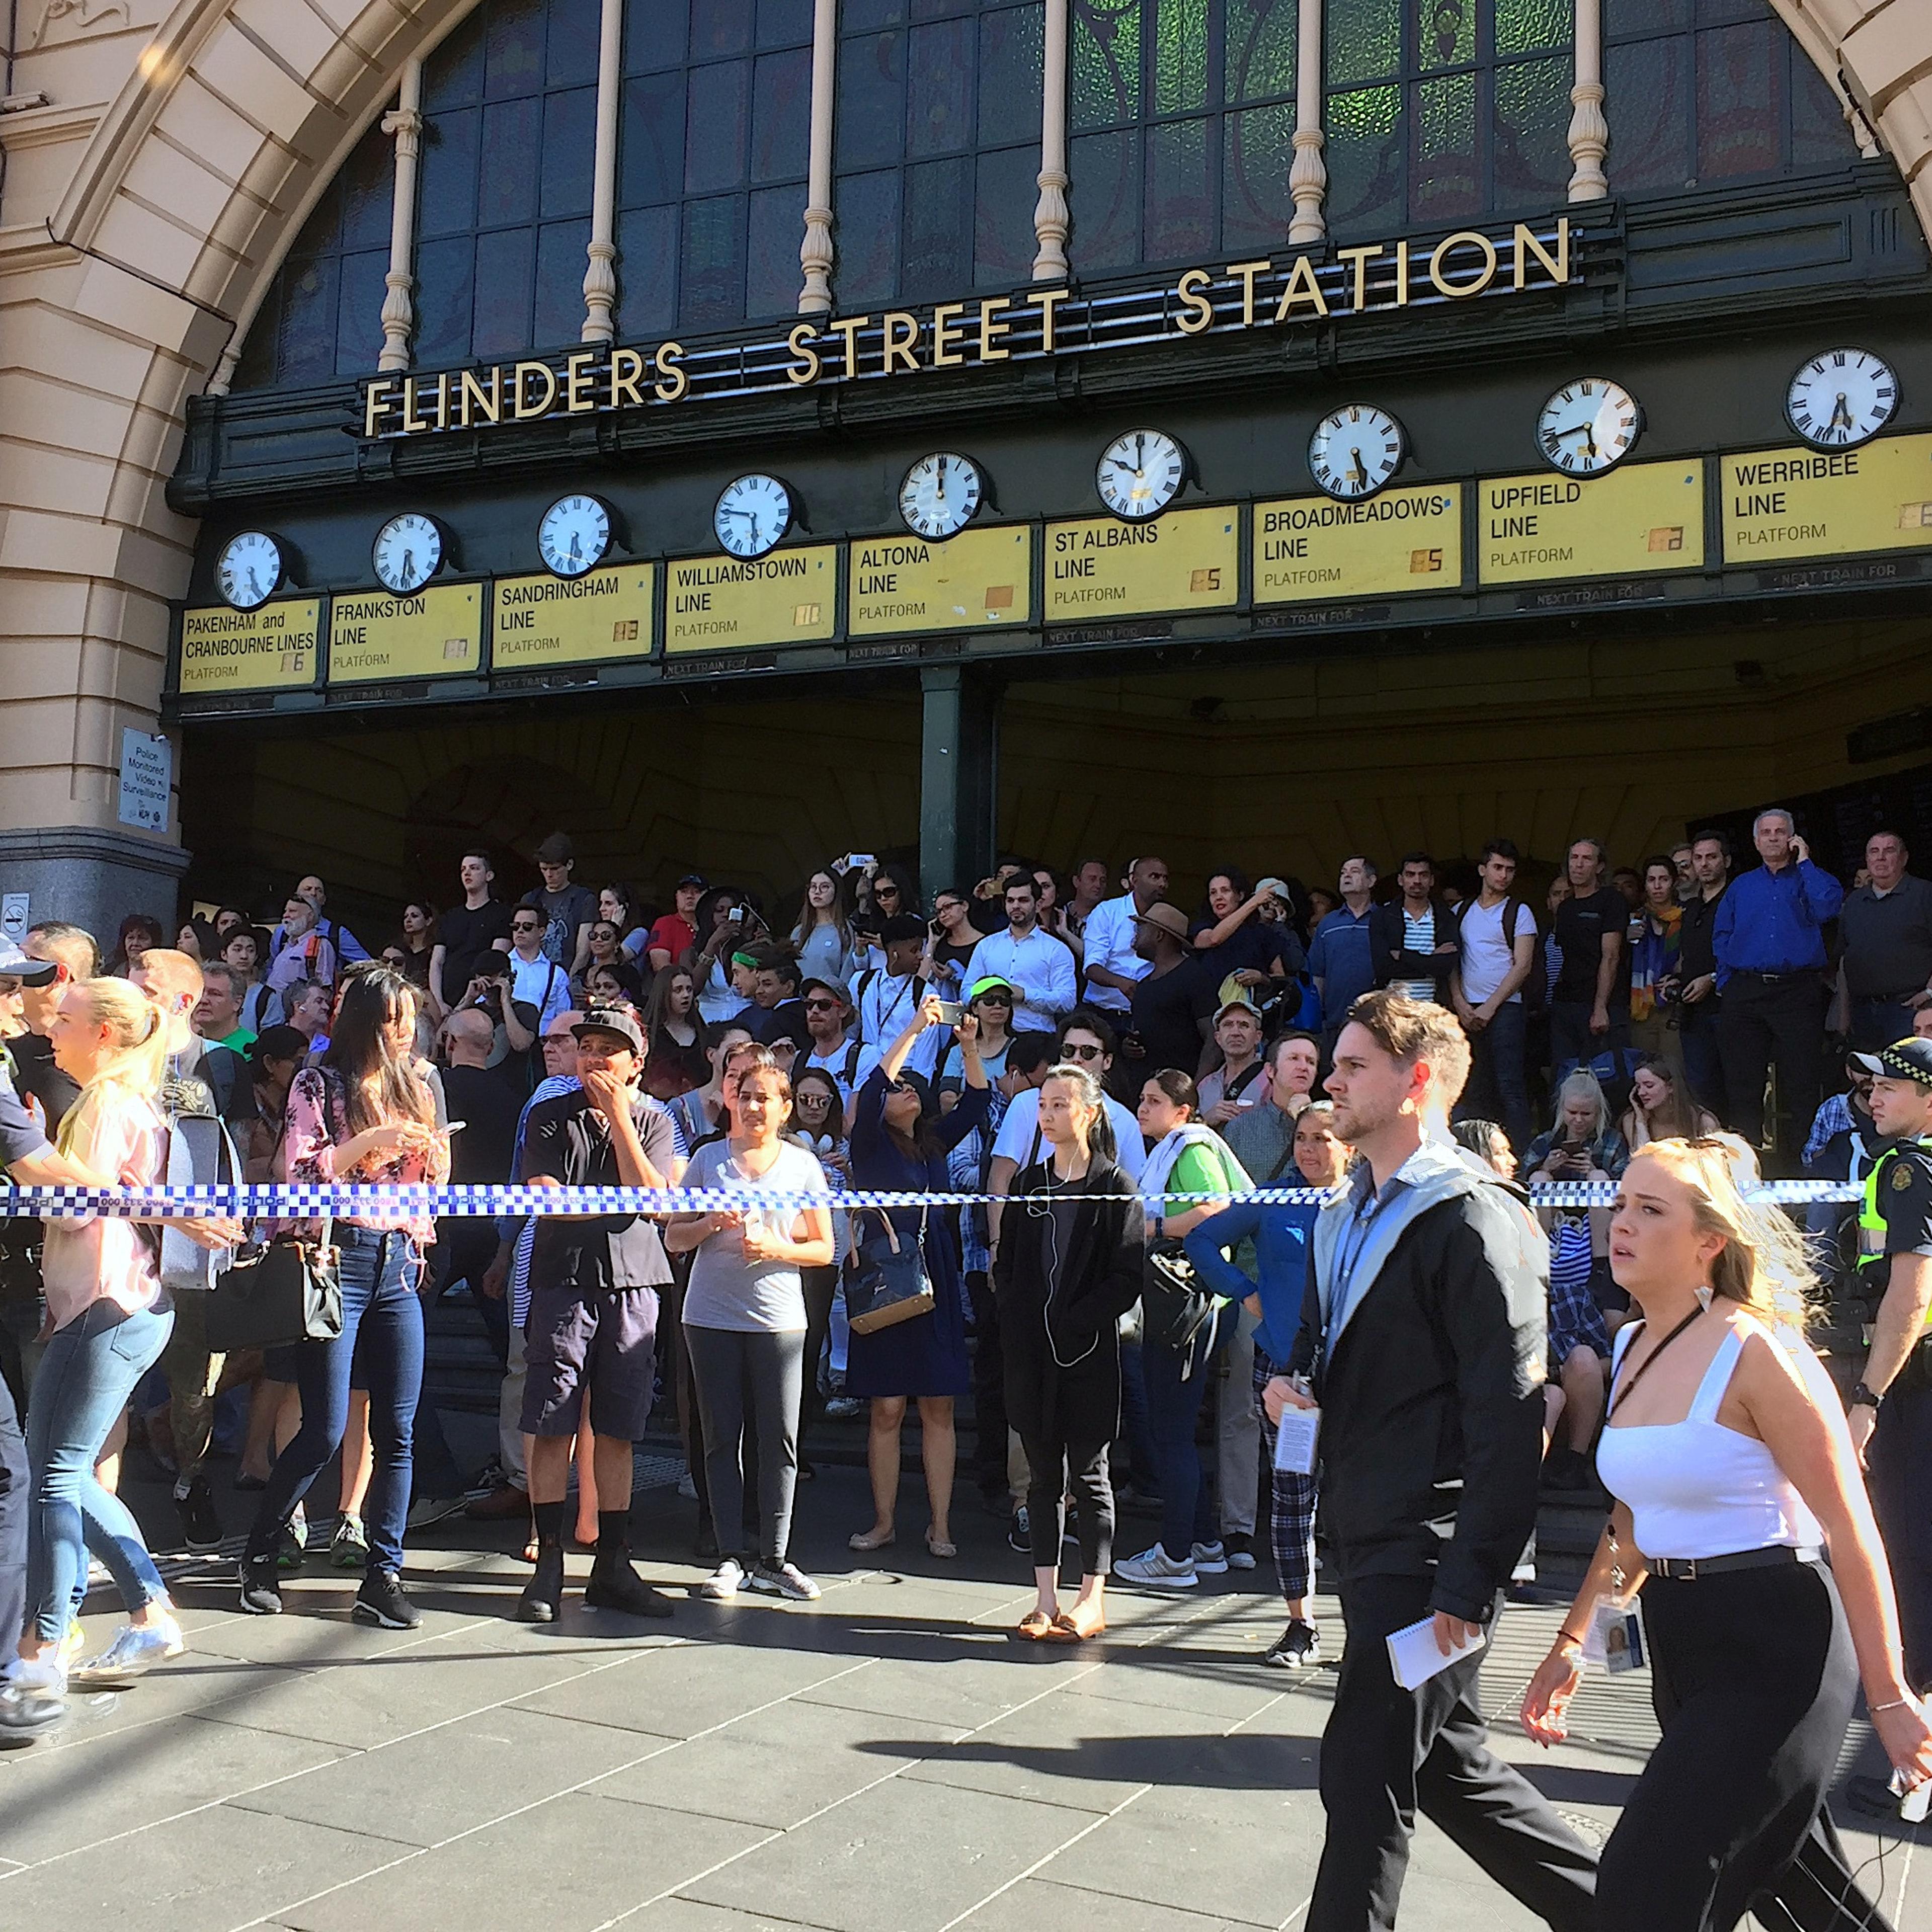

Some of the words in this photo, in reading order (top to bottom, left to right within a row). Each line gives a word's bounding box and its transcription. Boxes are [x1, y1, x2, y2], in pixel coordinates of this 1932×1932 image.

[365, 342, 687, 438] FLINDERS
[786, 290, 1069, 383] STREET
[1175, 217, 1569, 334] STATION
[1735, 453, 1859, 487] WERRIBEE
[1491, 482, 1581, 510] UPFIELD
[1735, 492, 1786, 517] LINE
[1264, 496, 1443, 532] BROADMEADOWS
[1492, 515, 1538, 539] LINE
[1737, 524, 1826, 545] PLATFORM
[1055, 532, 1078, 551] ST
[1083, 524, 1158, 549] ALBANS
[860, 545, 929, 568] ALTONA
[1265, 538, 1308, 560] LINE
[1491, 547, 1573, 567] PLATFORM
[1055, 557, 1095, 579] LINE
[1428, 548, 1442, 572] 5
[677, 557, 807, 587] WILLIAMSTOWN
[1208, 568, 1221, 590] 5
[1265, 568, 1341, 587] PLATFORM
[1869, 564, 1897, 577] FOR
[502, 577, 618, 605] SANDRINGHAM
[859, 574, 897, 594] LINE
[676, 593, 711, 613] LINE
[1055, 587, 1125, 604] PLATFORM
[336, 598, 425, 621] FRANKSTON
[859, 602, 925, 619] PLATFORM
[1290, 612, 1326, 625] TRAIN
[187, 614, 256, 634] PAKENHAM
[262, 612, 285, 629] and
[501, 611, 534, 630] LINE
[675, 620, 738, 637] PLATFORM
[186, 636, 274, 658] CRANBOURNE
[277, 632, 314, 651] LINES
[335, 627, 366, 646] LINE
[501, 637, 560, 653] PLATFORM
[334, 654, 389, 668] PLATFORM
[184, 666, 238, 680] PLATFORM
[136, 747, 158, 762] Police
[129, 758, 165, 776] Monitored
[123, 782, 167, 802] Surveillance
[101, 1198, 121, 1206] 000
[123, 1198, 142, 1206] 333
[333, 1196, 351, 1204] 000
[451, 1196, 502, 1204] POLICE
